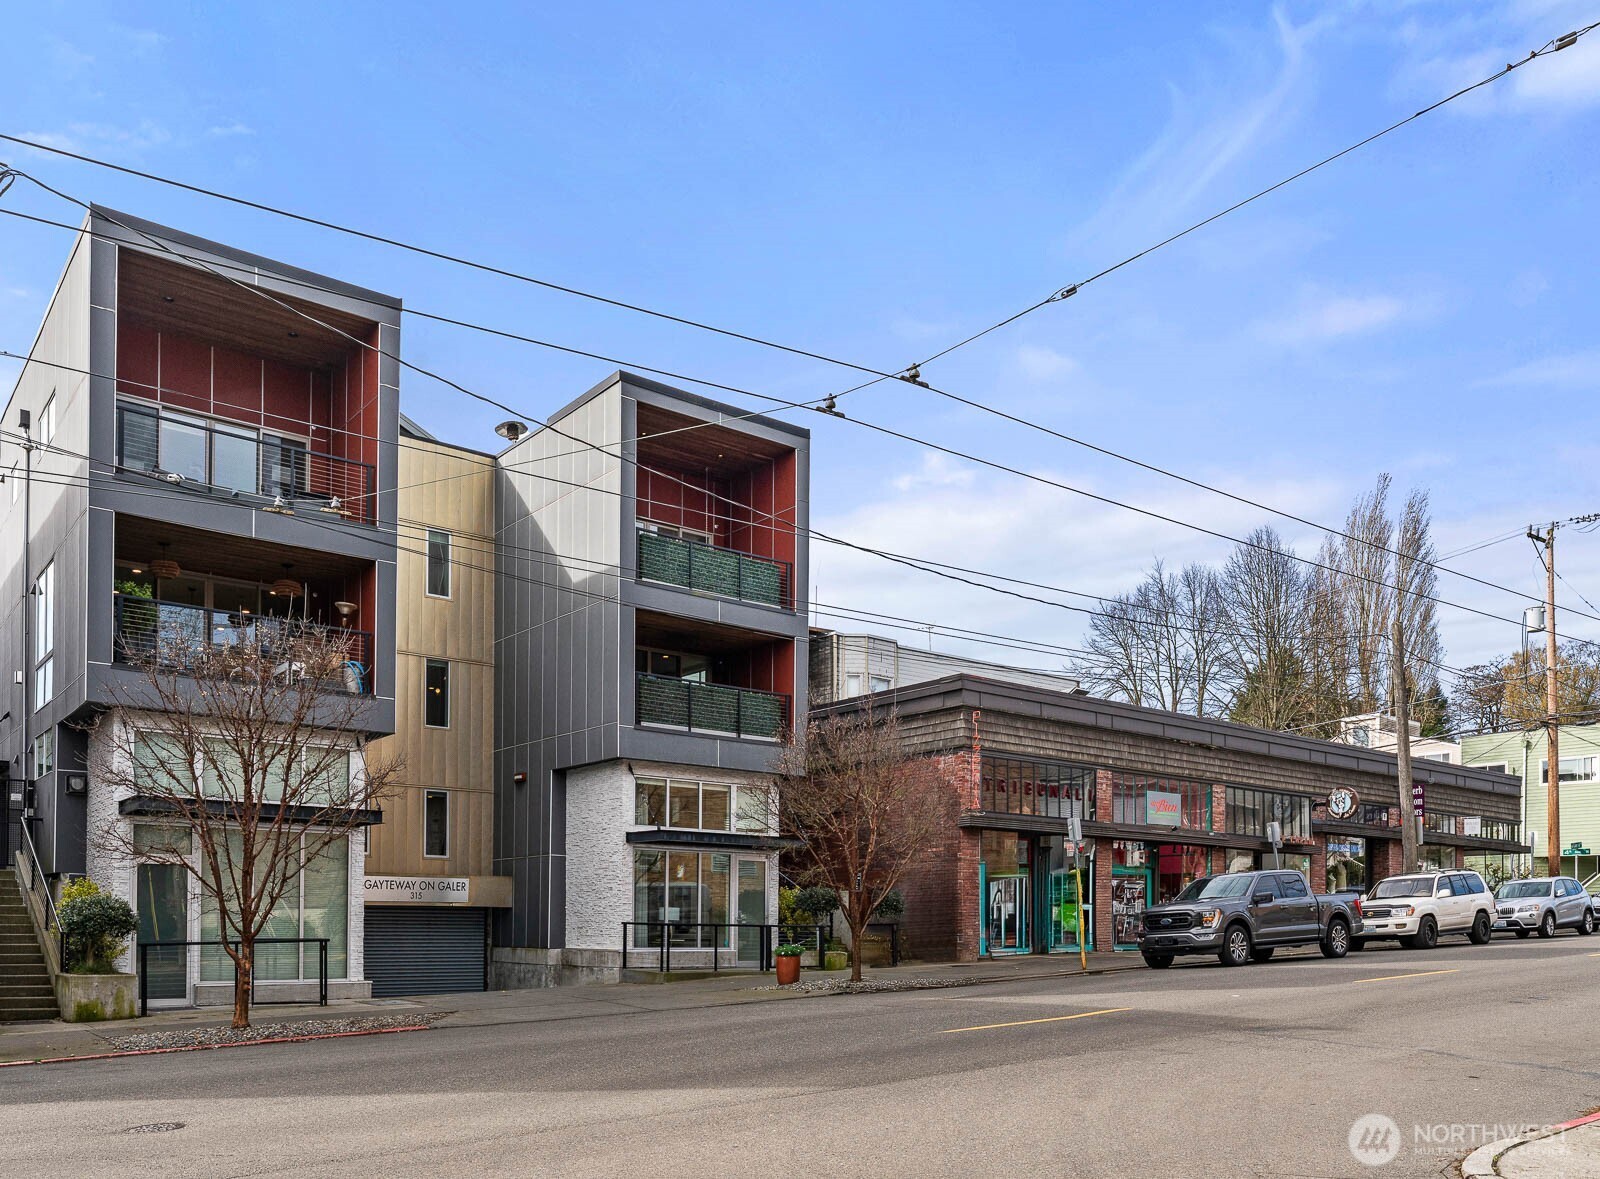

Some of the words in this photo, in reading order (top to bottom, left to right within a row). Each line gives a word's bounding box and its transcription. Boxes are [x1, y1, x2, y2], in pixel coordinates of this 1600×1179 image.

[419, 881, 435, 891] ON
[438, 881, 467, 892] GALER
[410, 892, 423, 900] 315
